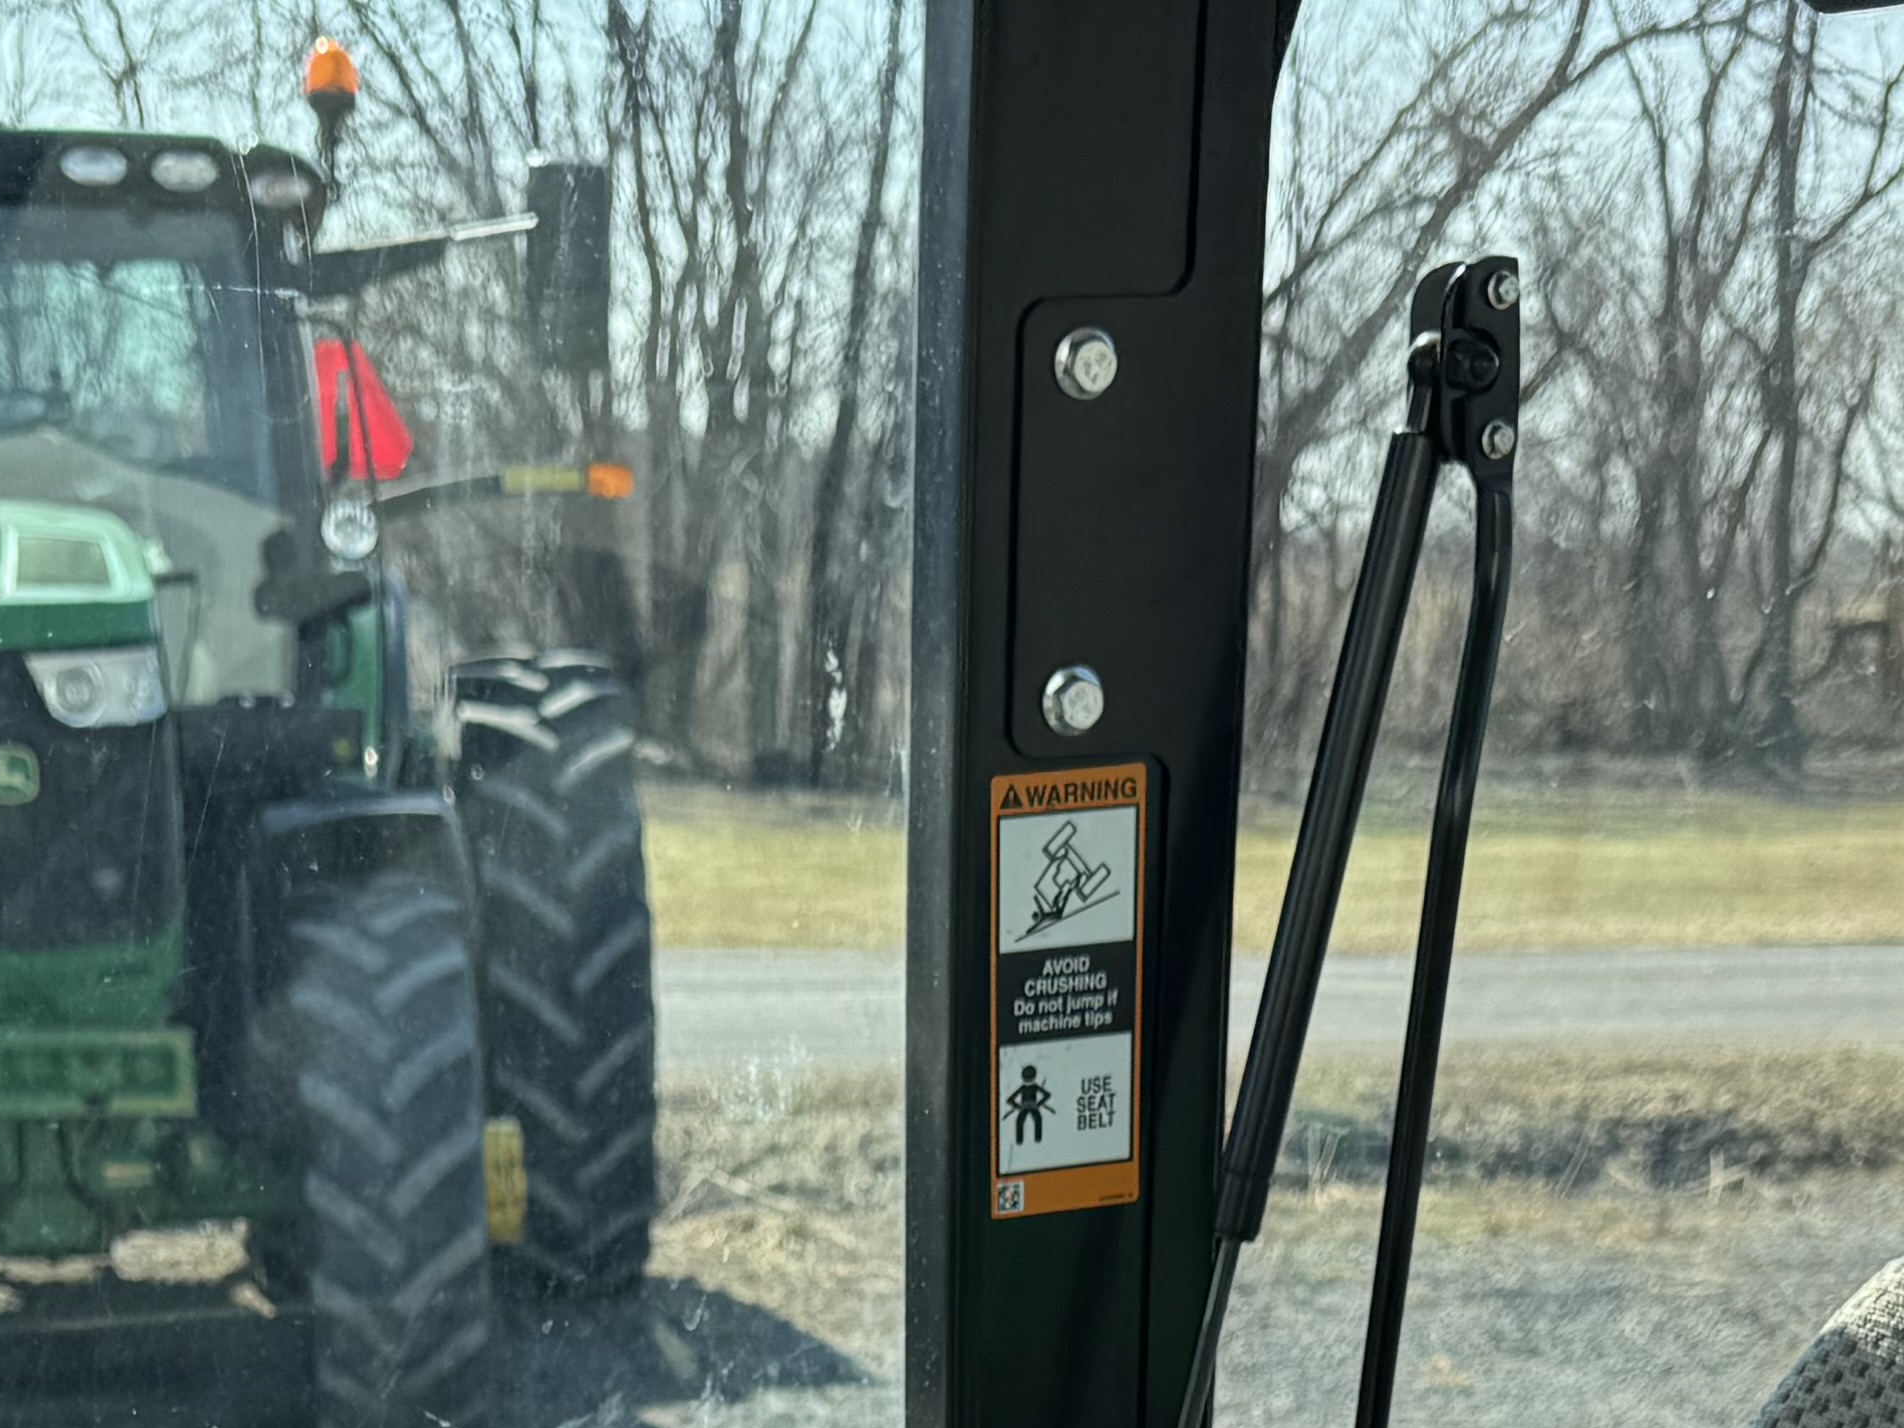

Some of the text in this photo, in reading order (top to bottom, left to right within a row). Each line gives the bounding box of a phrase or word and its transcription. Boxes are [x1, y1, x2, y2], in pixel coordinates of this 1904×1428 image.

[1026, 777, 1137, 807] WARNING
[1043, 957, 1090, 976] AVOID
[1024, 974, 1107, 997] CRUSHING
[1013, 990, 1119, 1016] Do not jump if
[1018, 1012, 1113, 1035] machine tips
[1081, 1076, 1112, 1094] USE
[1077, 1093, 1116, 1113] SEAT
[1077, 1112, 1115, 1131] BELT
